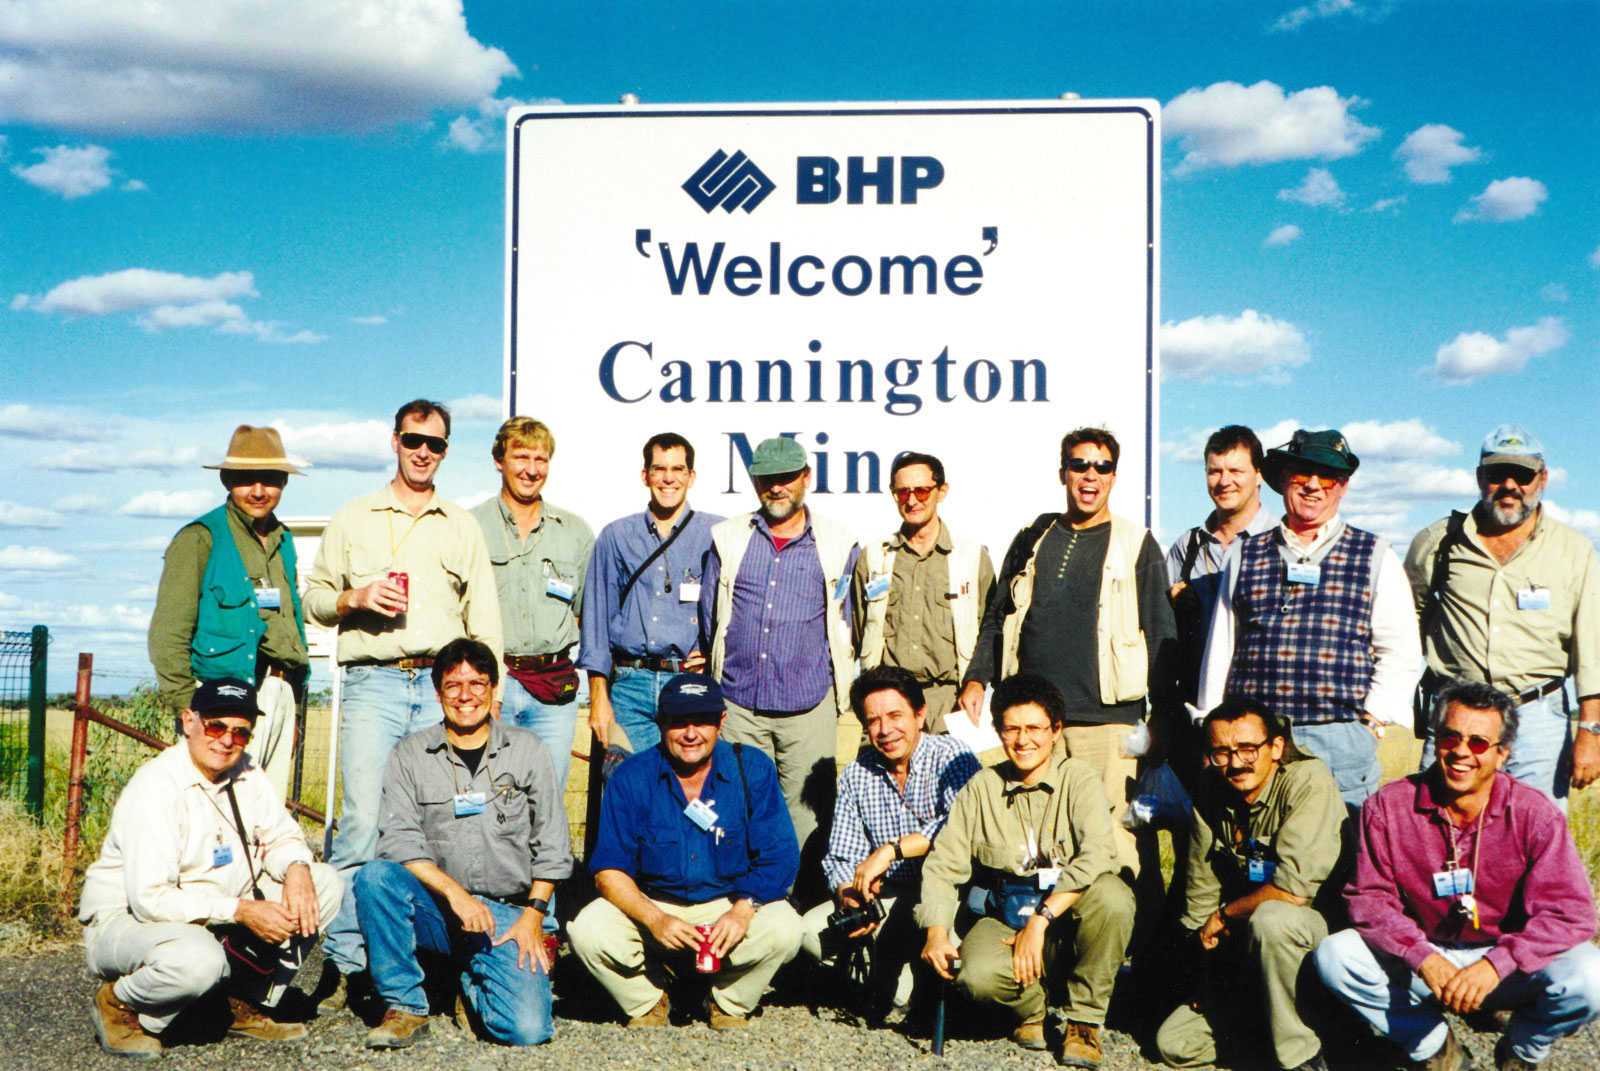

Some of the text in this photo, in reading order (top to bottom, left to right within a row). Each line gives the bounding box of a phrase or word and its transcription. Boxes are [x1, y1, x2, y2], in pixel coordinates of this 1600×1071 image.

[796, 156, 945, 205] BHP
[598, 339, 1049, 416] Cannington
[721, 431, 916, 494] Min
